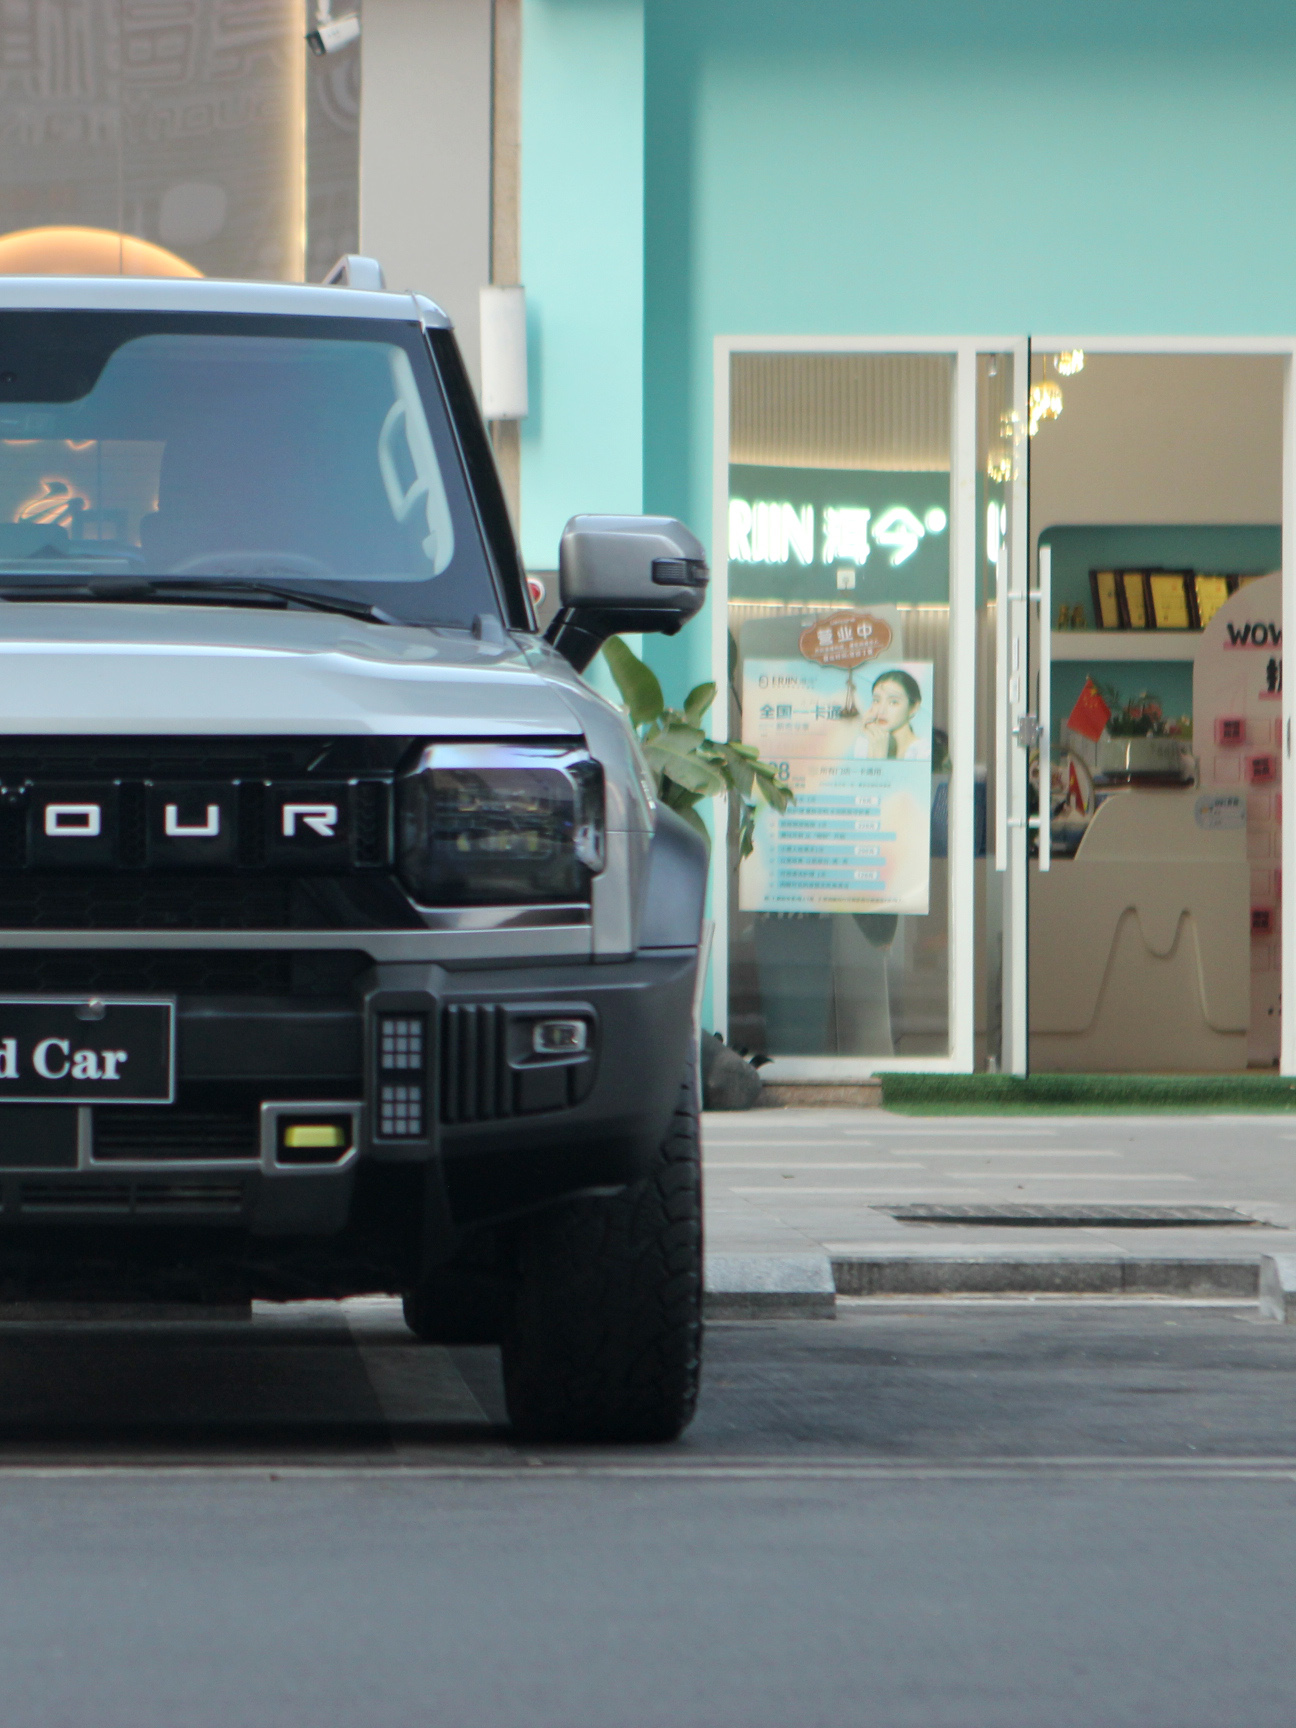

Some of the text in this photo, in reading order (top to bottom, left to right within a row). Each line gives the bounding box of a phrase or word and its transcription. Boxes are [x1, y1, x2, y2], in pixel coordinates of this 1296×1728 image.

[816, 621, 873, 647] 营业中
[759, 703, 843, 721] 全国一卡通
[32, 1037, 129, 1080] Car
